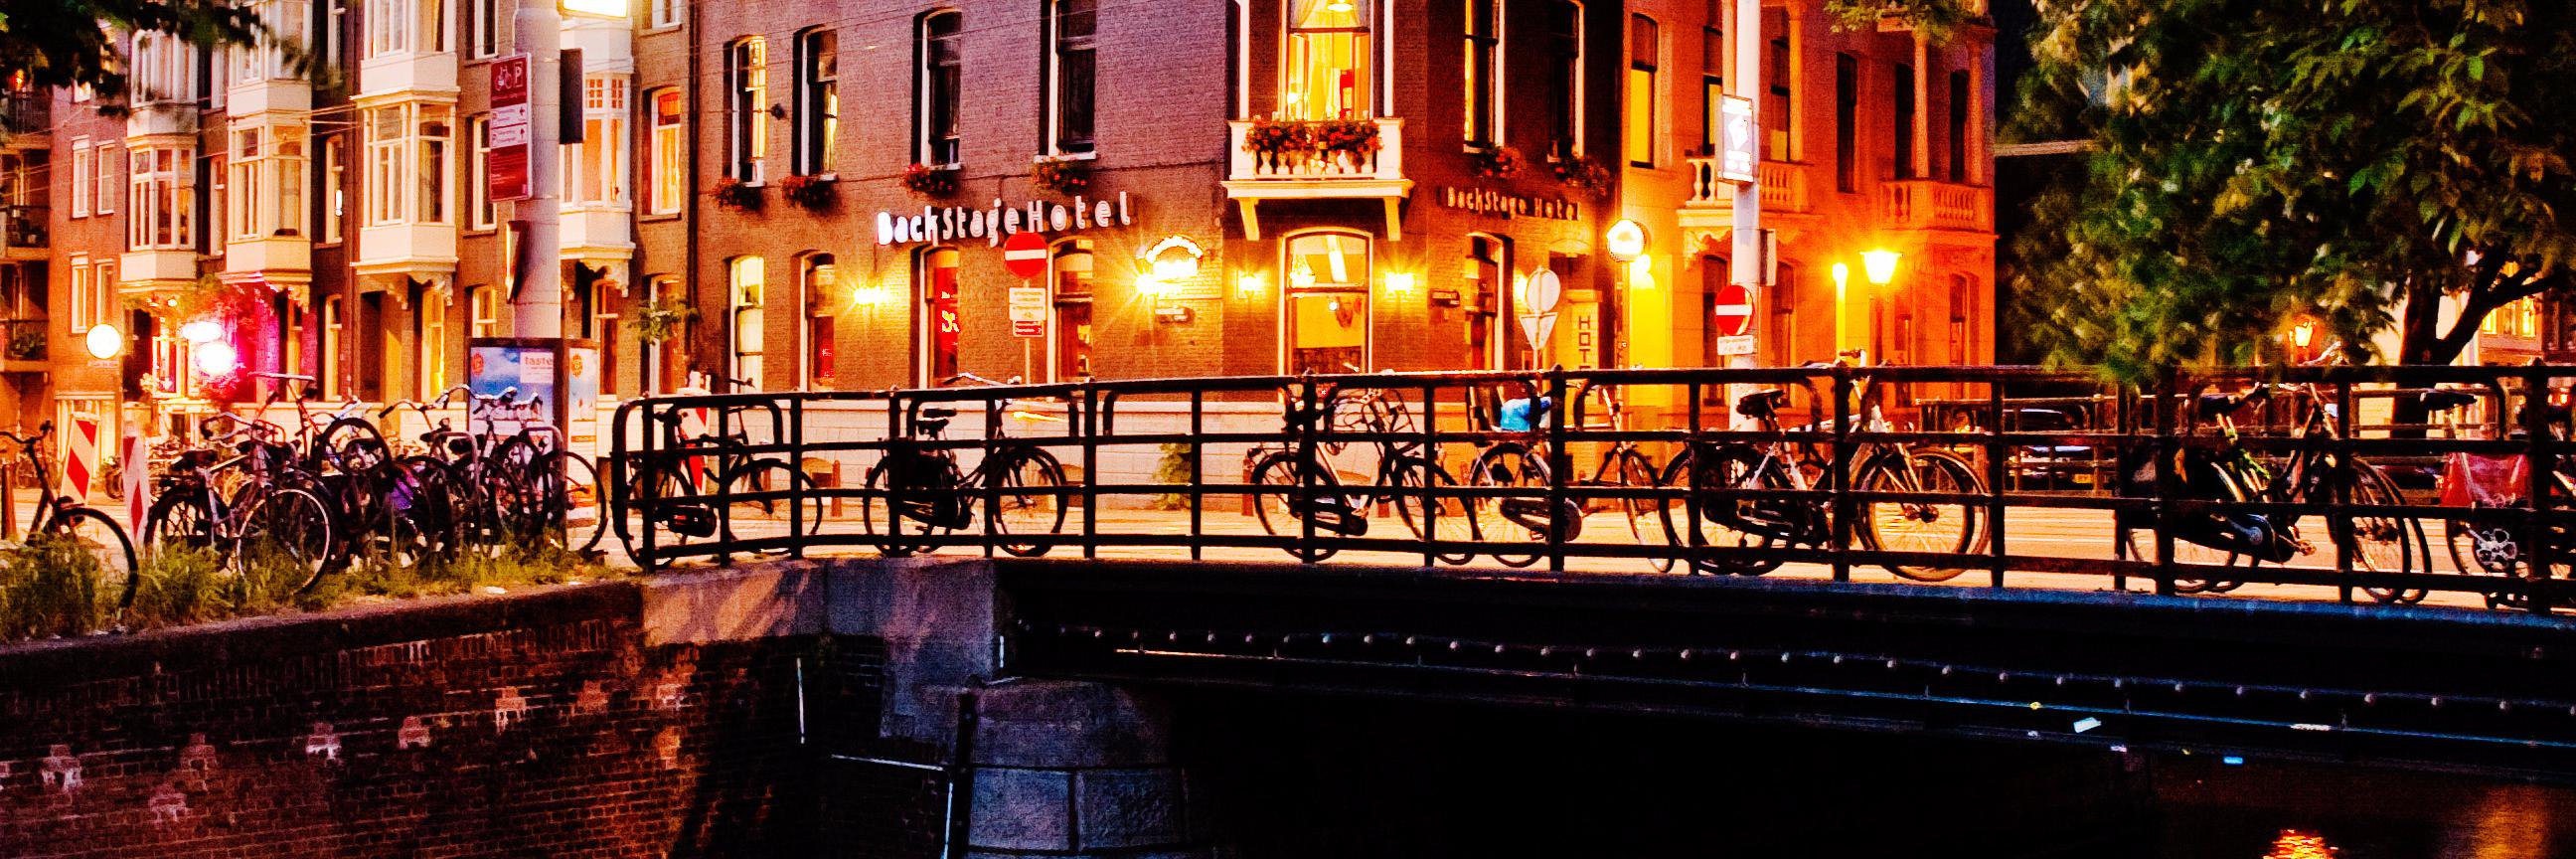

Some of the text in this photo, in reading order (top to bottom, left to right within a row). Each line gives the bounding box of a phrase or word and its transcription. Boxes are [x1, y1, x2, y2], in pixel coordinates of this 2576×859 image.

[1027, 191, 1131, 233] Hotel
[1533, 197, 1582, 221] Hotel
[1578, 315, 1591, 369] HOT
